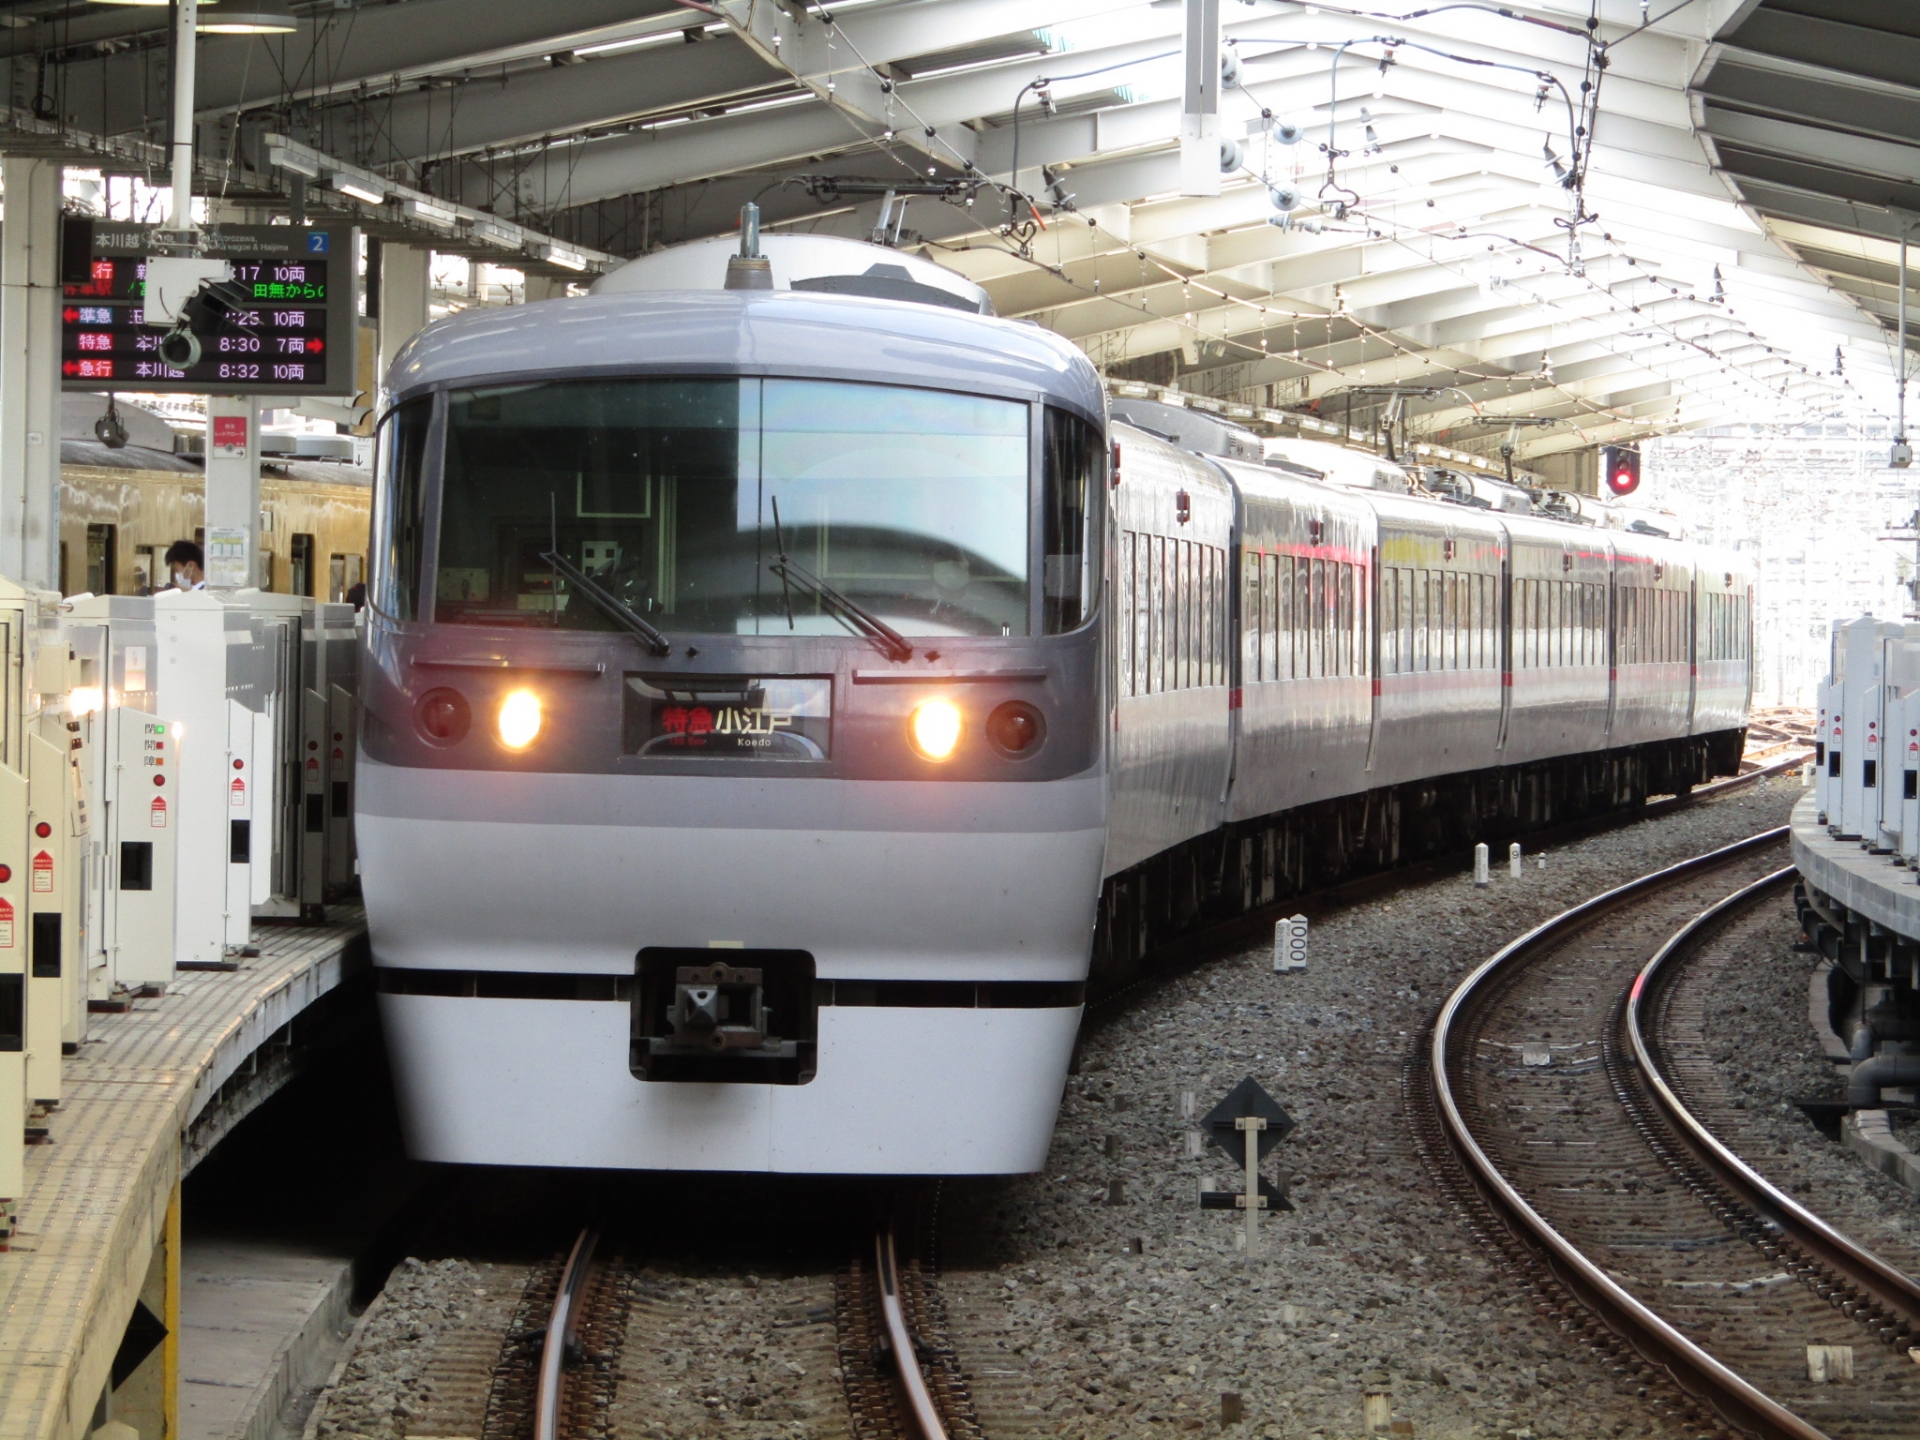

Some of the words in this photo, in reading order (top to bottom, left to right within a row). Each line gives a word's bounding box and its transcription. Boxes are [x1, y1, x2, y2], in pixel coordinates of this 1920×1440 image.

[260, 243, 289, 253] Haijima
[313, 235, 324, 252] 2
[92, 263, 113, 279] 行
[274, 266, 306, 282] 10両
[80, 307, 113, 324] 準急
[226, 311, 260, 326] :25
[274, 310, 305, 327] 10両
[79, 334, 113, 350] 特急
[219, 337, 261, 352] 8:30
[277, 337, 305, 354] 7両
[80, 360, 113, 377] 急行
[219, 363, 260, 378] 8:32
[273, 363, 305, 380] 10両
[662, 706, 713, 733] 特急
[715, 707, 792, 735] 小江戸
[737, 738, 772, 747] Koedo
[1290, 920, 1307, 961] 1000
